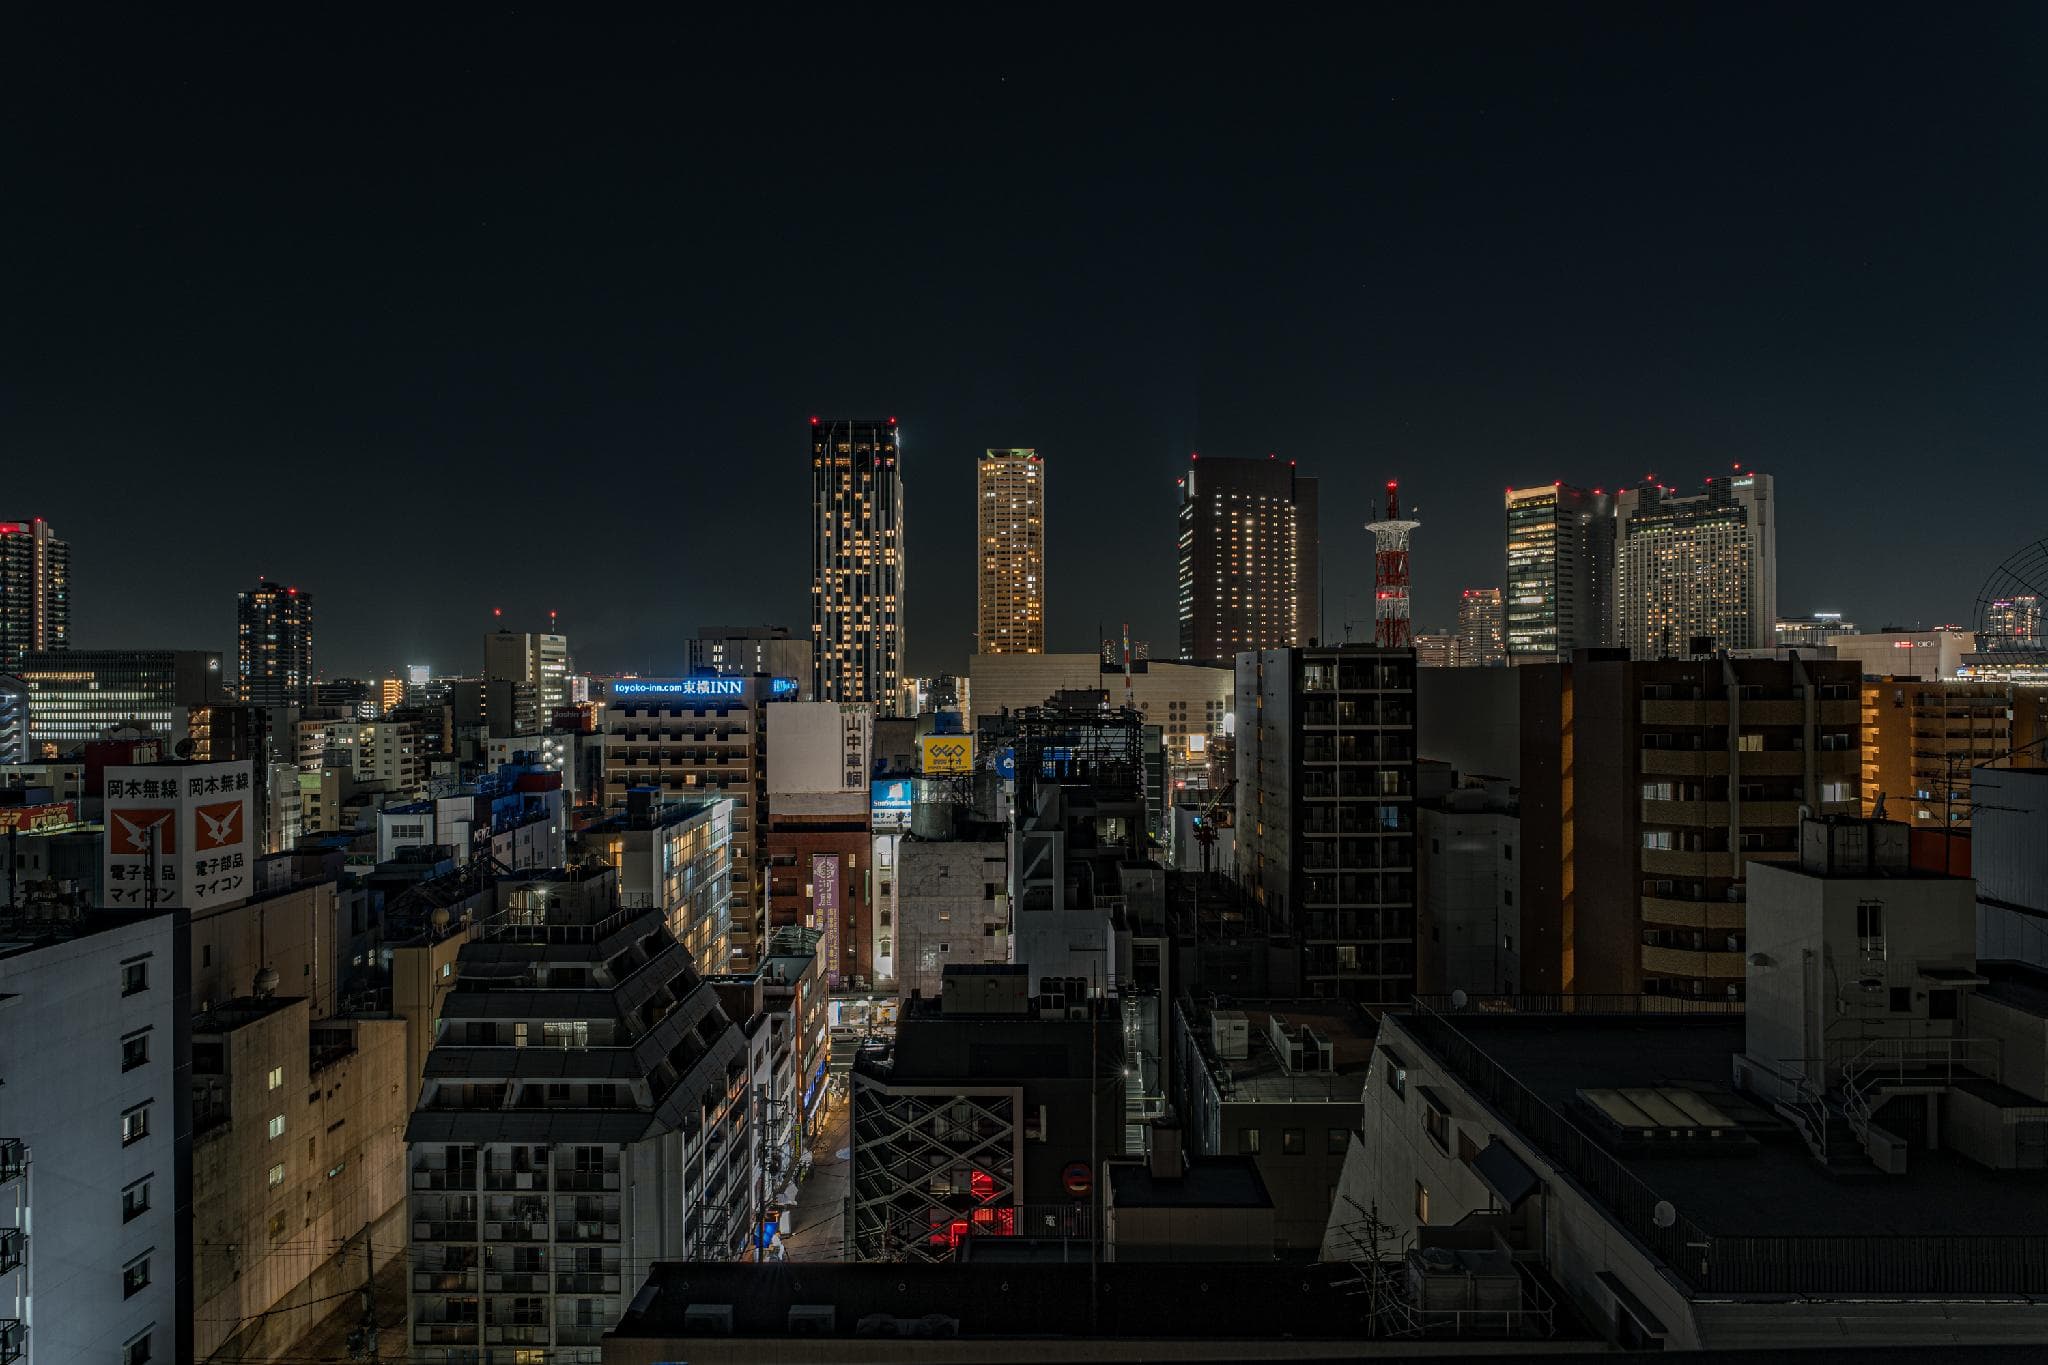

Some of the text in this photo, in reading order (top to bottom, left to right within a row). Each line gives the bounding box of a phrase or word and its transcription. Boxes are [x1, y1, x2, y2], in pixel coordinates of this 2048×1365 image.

[614, 680, 742, 695] toyoko-inn.com 東横INN
[930, 744, 966, 758] GEO
[108, 779, 178, 799] 岡本無線
[189, 772, 249, 797] 岡本無線
[195, 852, 244, 877] 電子部品
[195, 875, 243, 898] マイコン
